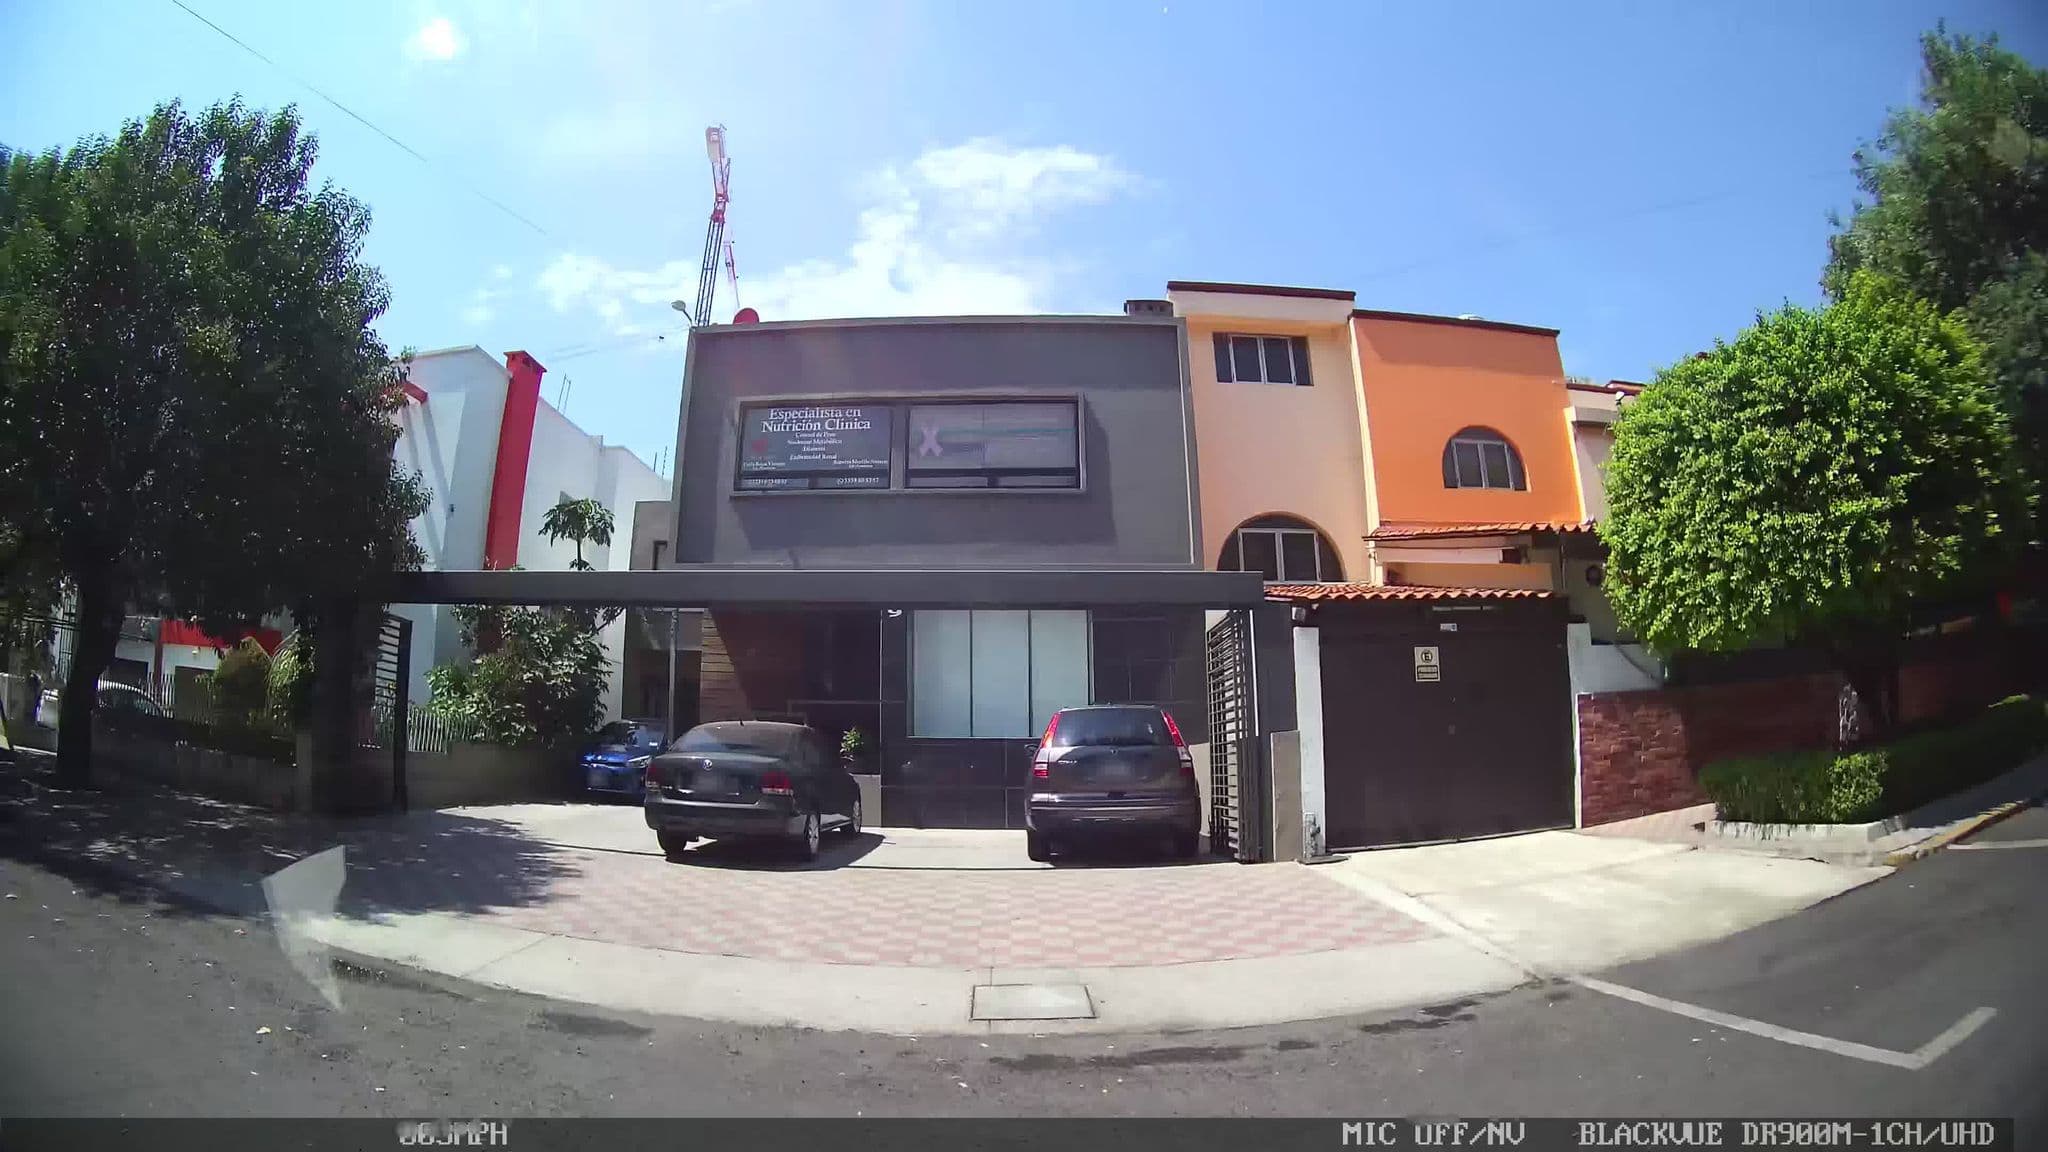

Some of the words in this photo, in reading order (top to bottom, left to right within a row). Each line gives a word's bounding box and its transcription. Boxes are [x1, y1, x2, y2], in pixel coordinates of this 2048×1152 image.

[769, 407, 843, 422] Especialista
[846, 408, 861, 418] en
[761, 419, 821, 433] Nutrición
